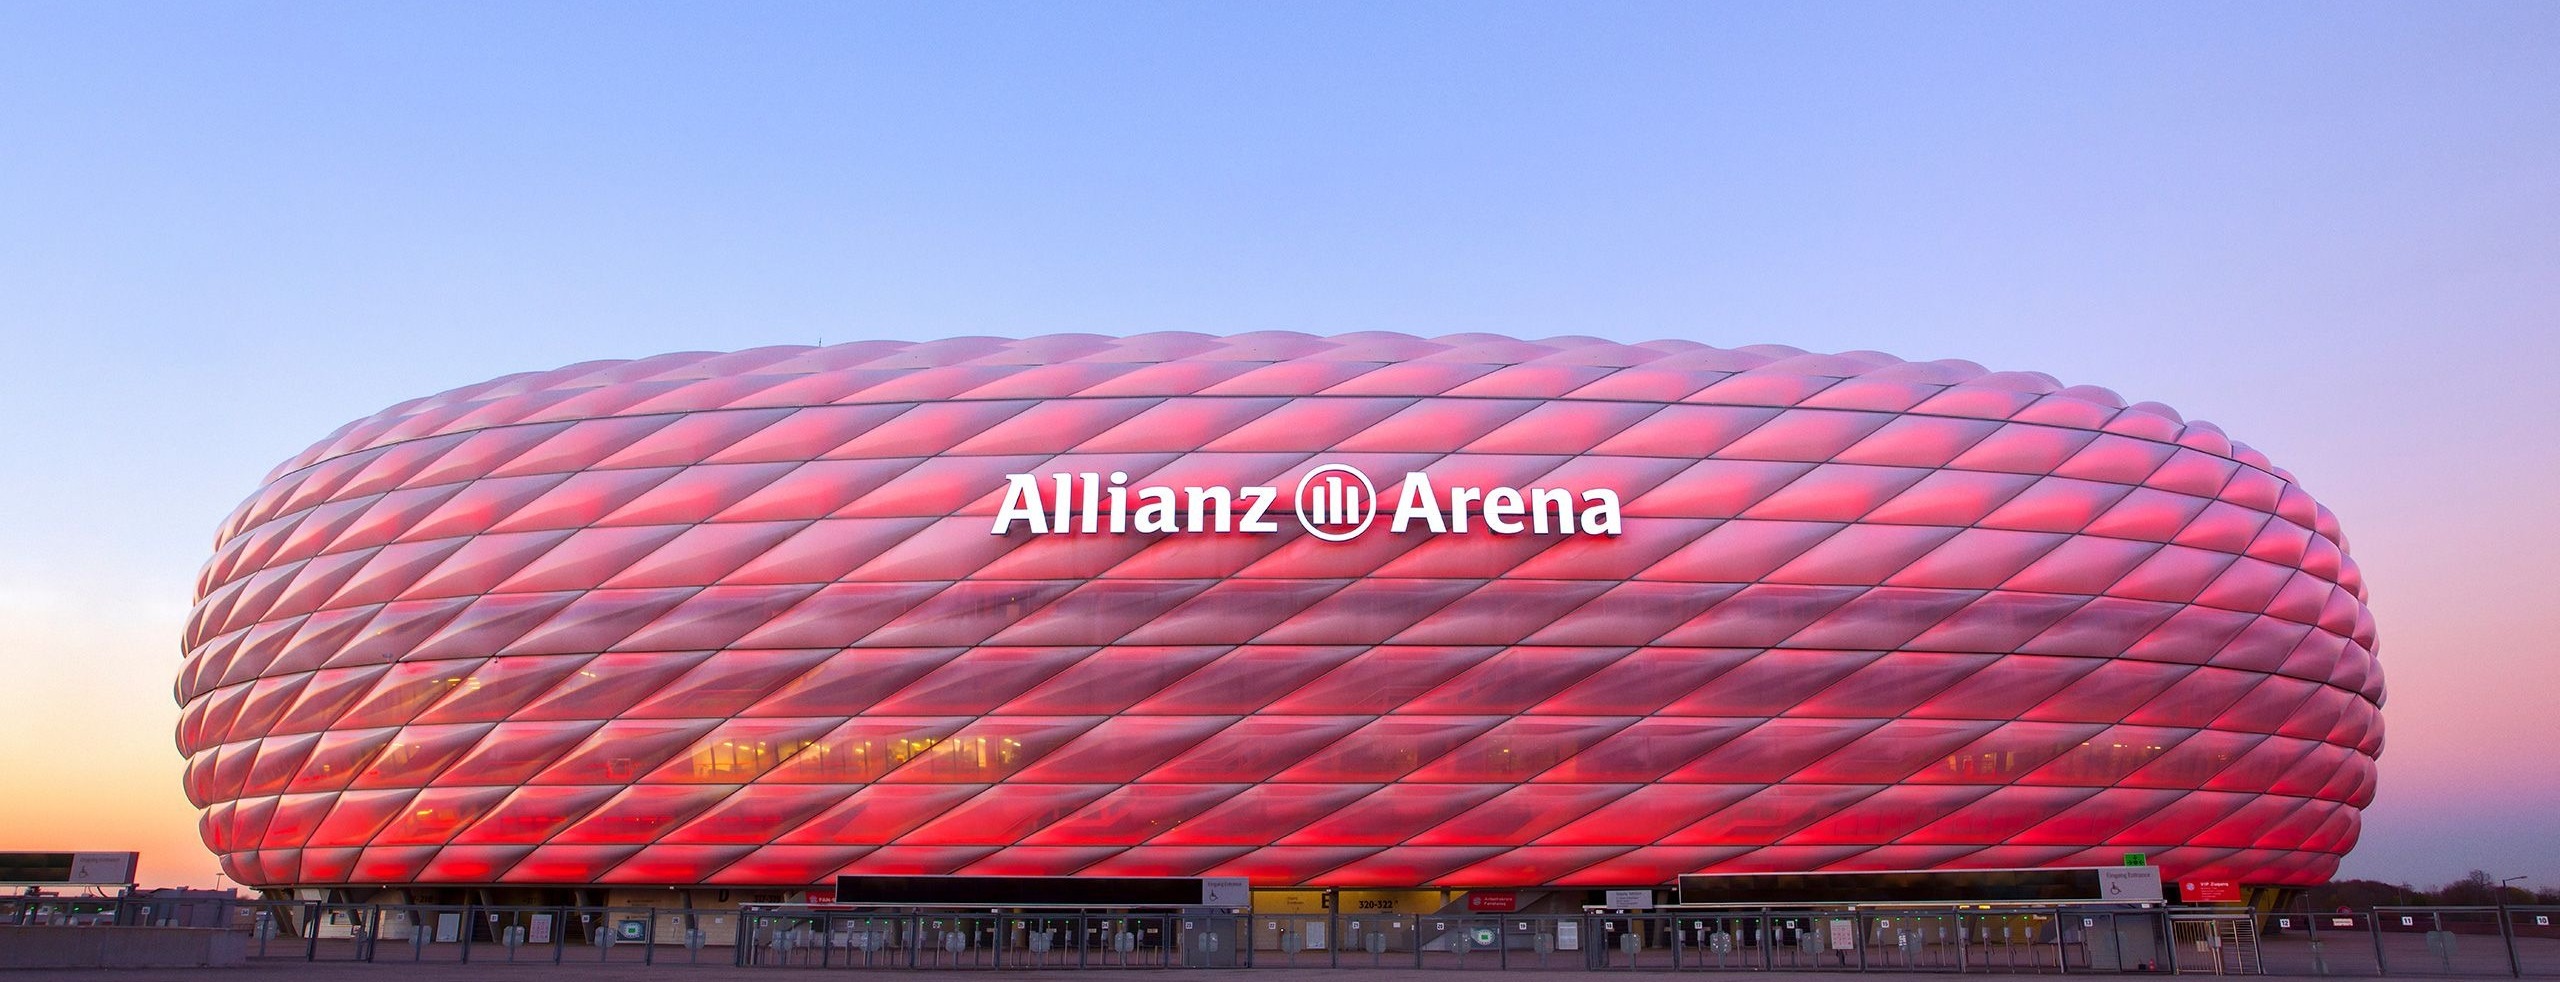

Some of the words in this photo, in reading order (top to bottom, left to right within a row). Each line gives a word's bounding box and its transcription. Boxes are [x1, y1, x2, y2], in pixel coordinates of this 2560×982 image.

[991, 470, 1278, 535] Allianz
[1390, 471, 1622, 535] Arena
[719, 889, 729, 902] D
[1321, 893, 1330, 909] E
[1359, 900, 1393, 909] 320-322
